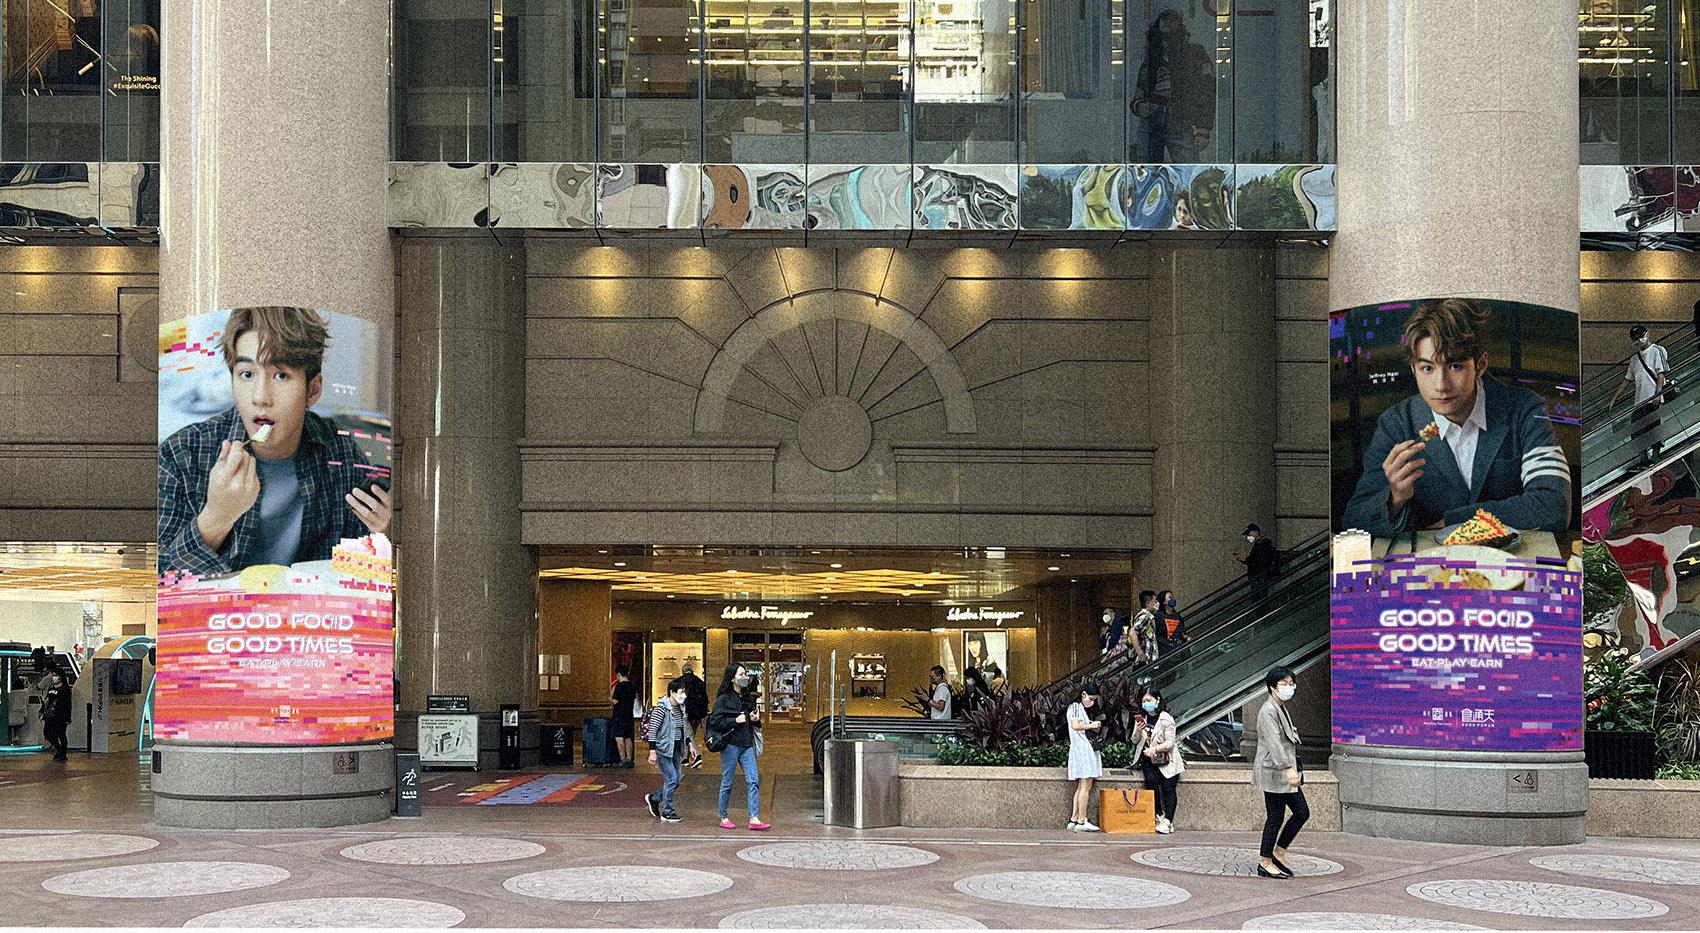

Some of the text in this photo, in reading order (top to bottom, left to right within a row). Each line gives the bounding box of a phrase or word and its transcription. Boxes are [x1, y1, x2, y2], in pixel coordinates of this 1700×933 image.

[132, 75, 157, 84] Shining
[208, 613, 354, 631] GOOD FOOD
[1379, 608, 1534, 628] GOOD FOOD
[207, 636, 354, 654] GOOD TIMES
[1379, 633, 1534, 654] GOOD TIMES
